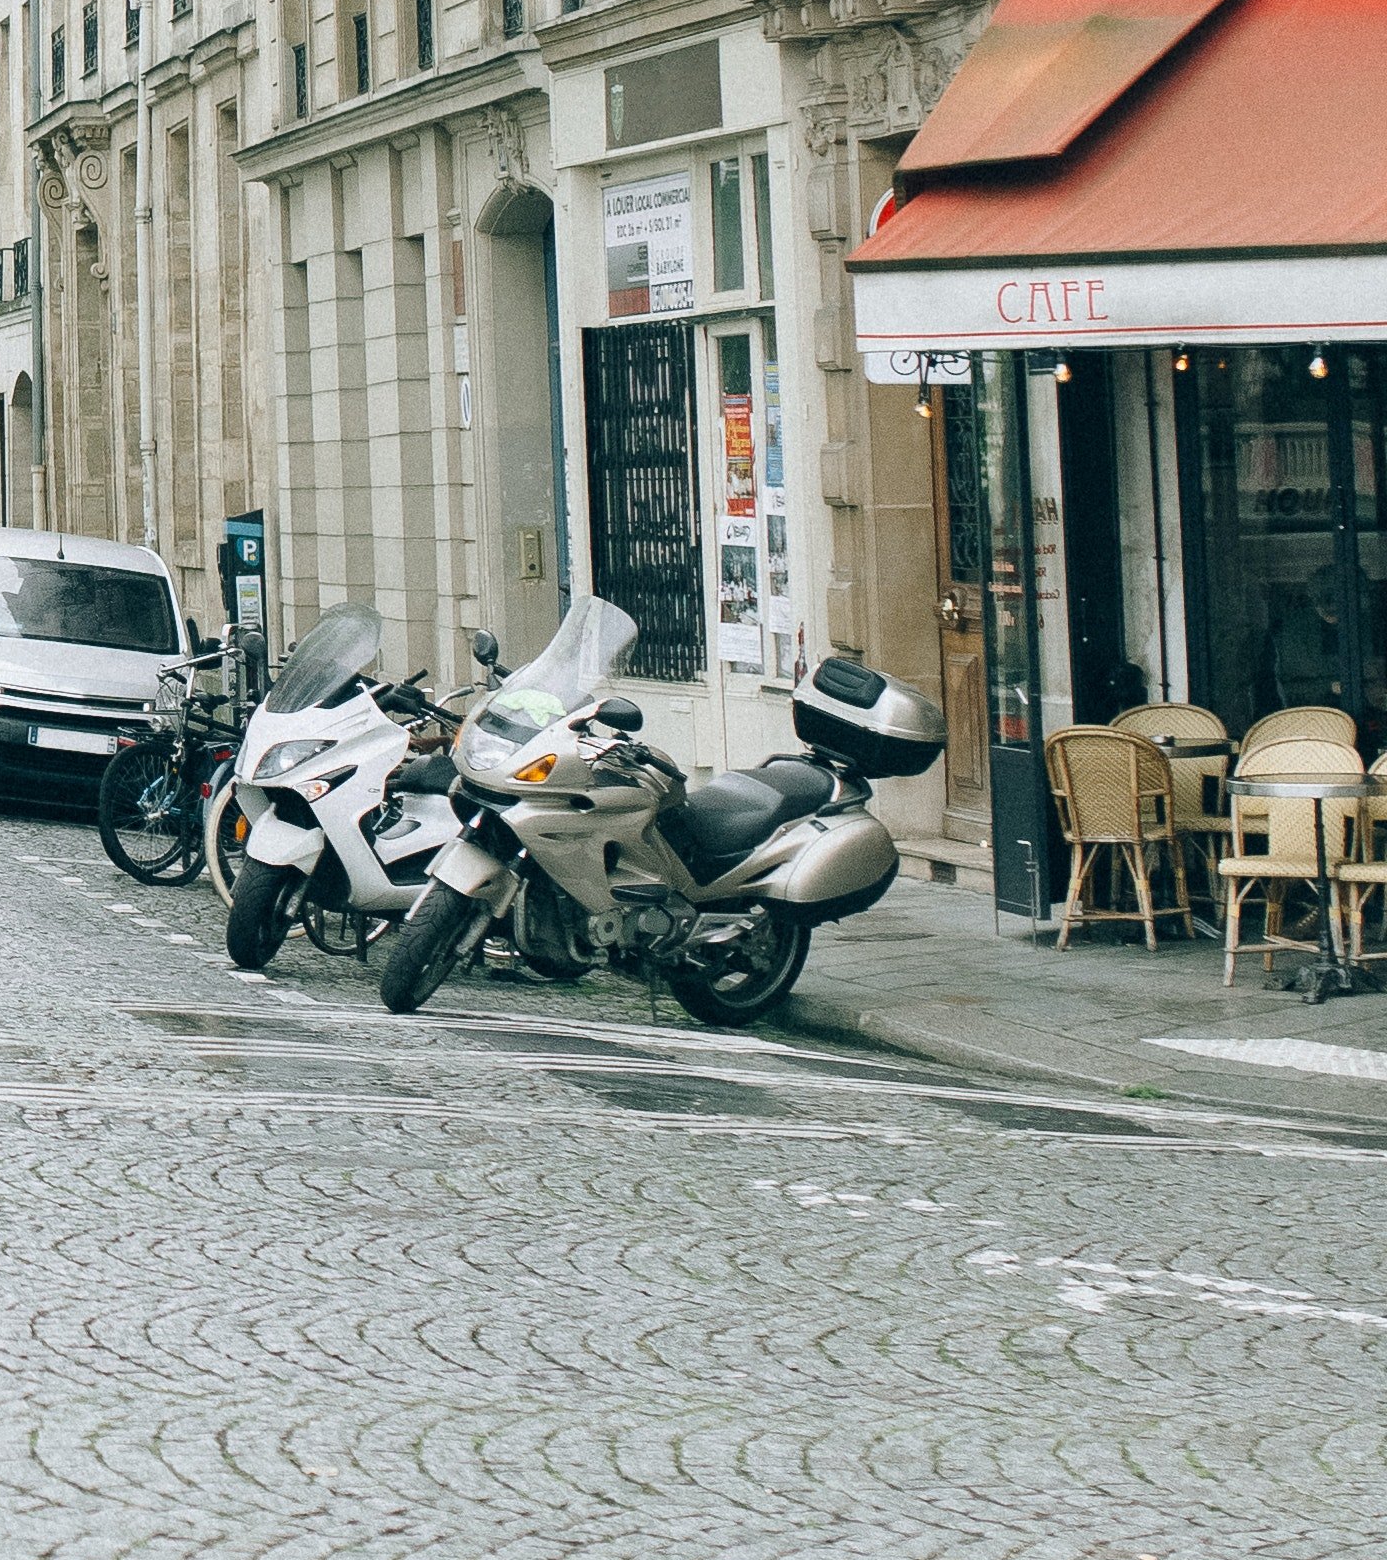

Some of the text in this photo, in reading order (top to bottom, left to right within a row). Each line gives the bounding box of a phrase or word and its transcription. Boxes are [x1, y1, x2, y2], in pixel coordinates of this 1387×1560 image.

[613, 194, 634, 216] LOUER
[635, 194, 653, 212] LOCAL
[997, 280, 1108, 323] CAFE
